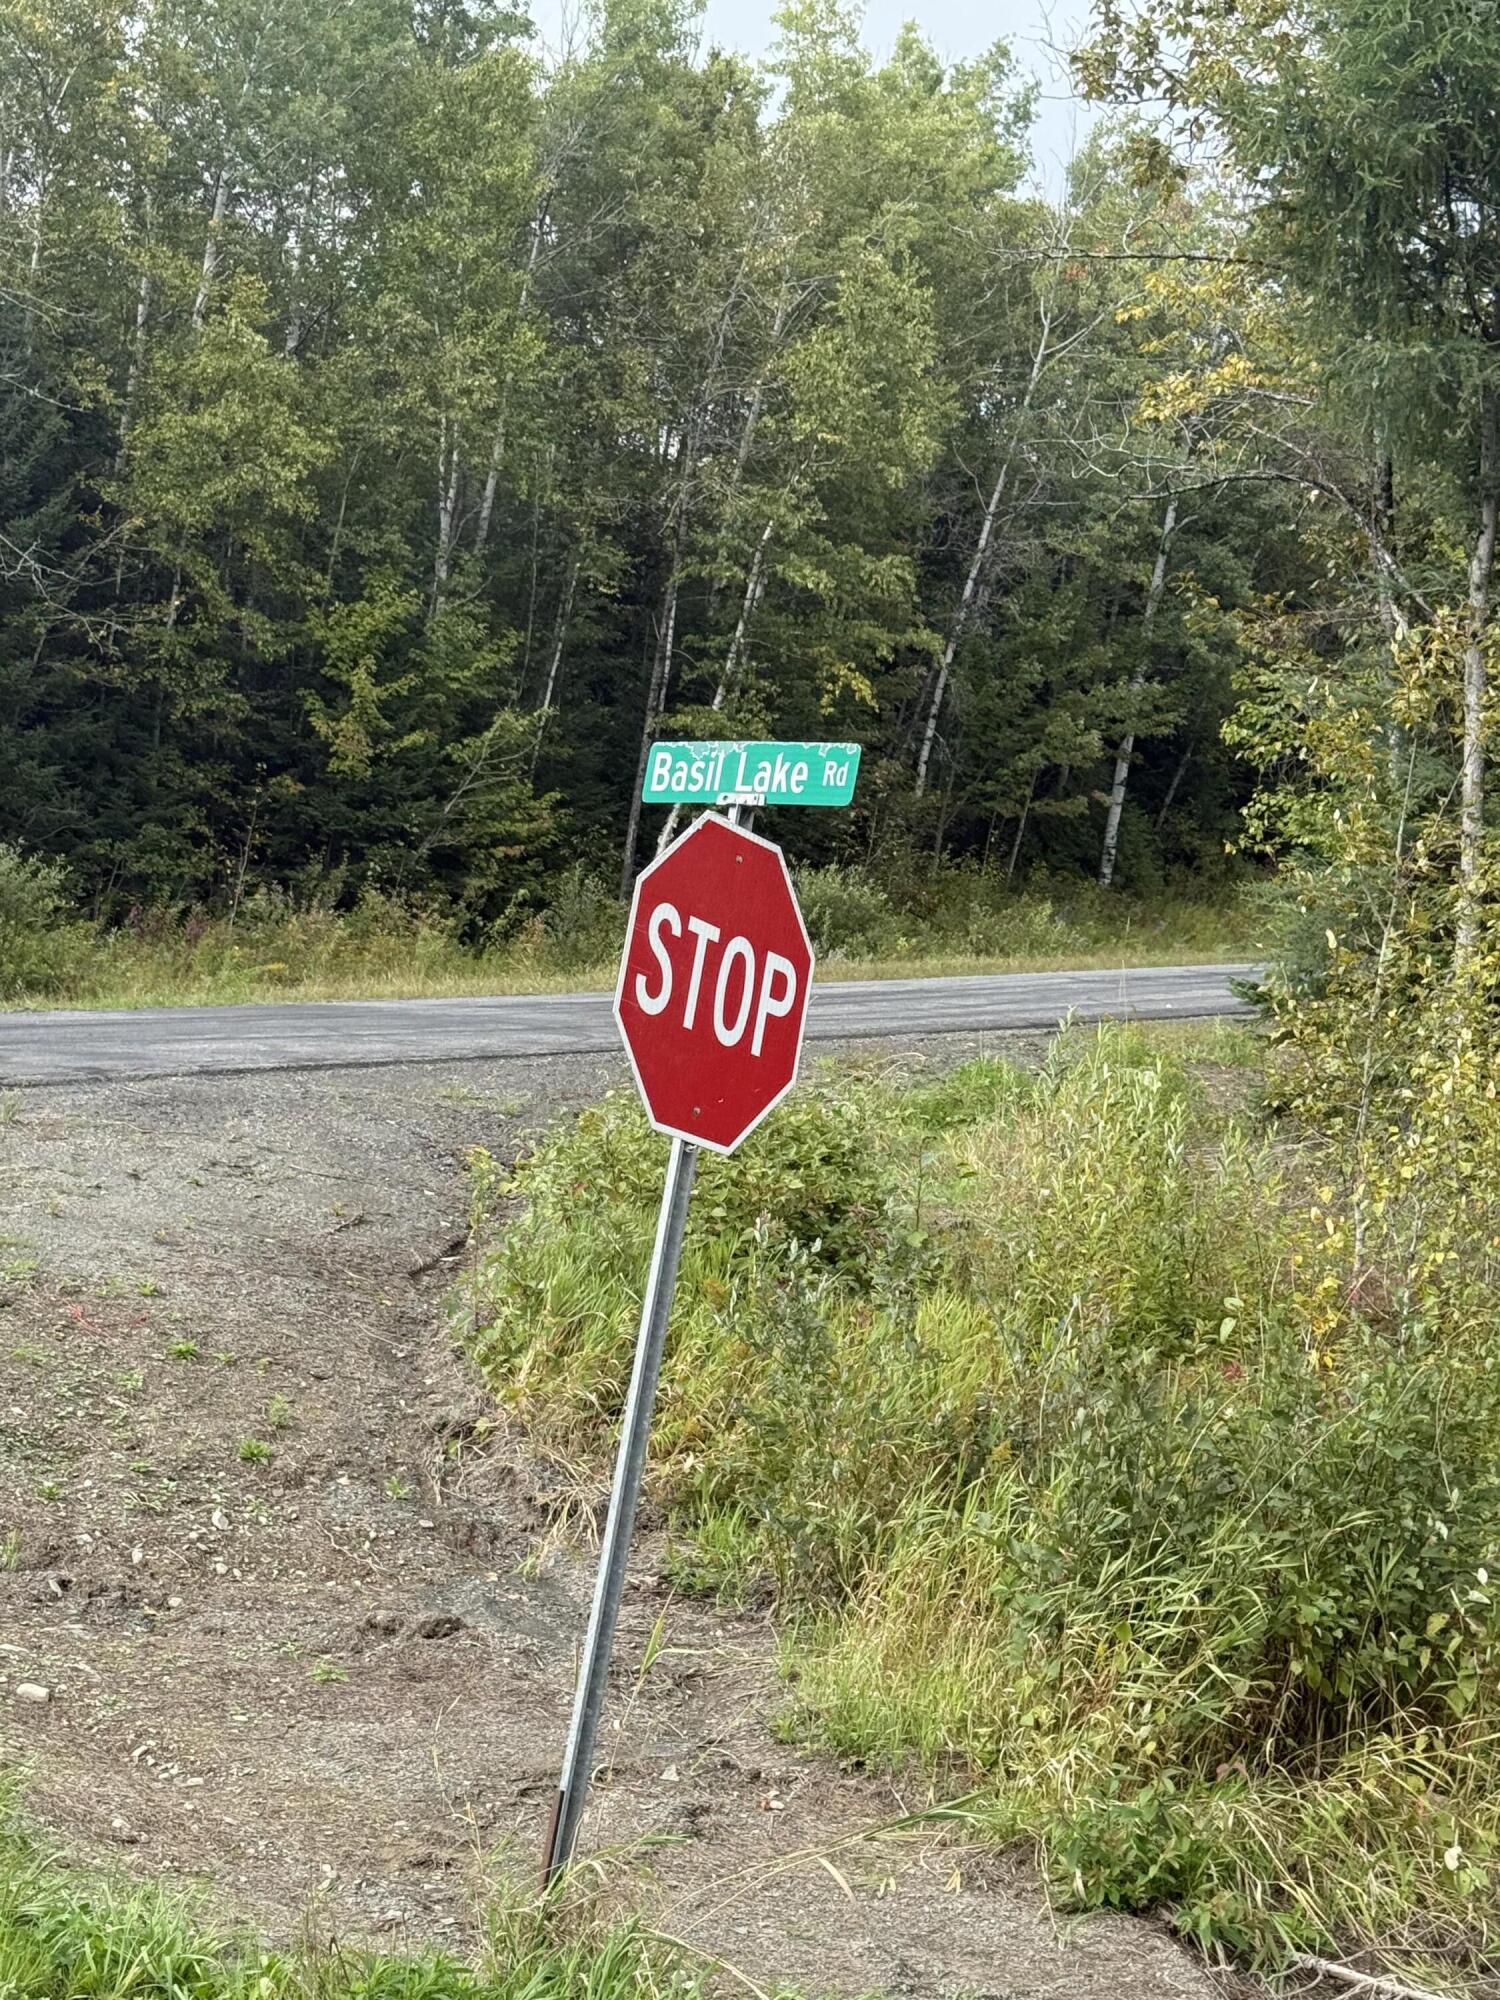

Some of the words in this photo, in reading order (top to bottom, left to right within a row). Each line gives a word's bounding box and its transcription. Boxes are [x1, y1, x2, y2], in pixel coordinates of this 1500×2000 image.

[650, 751, 724, 792] Basil
[735, 751, 808, 793] Lake
[822, 761, 850, 787] Rd
[635, 902, 797, 1057] STOP
